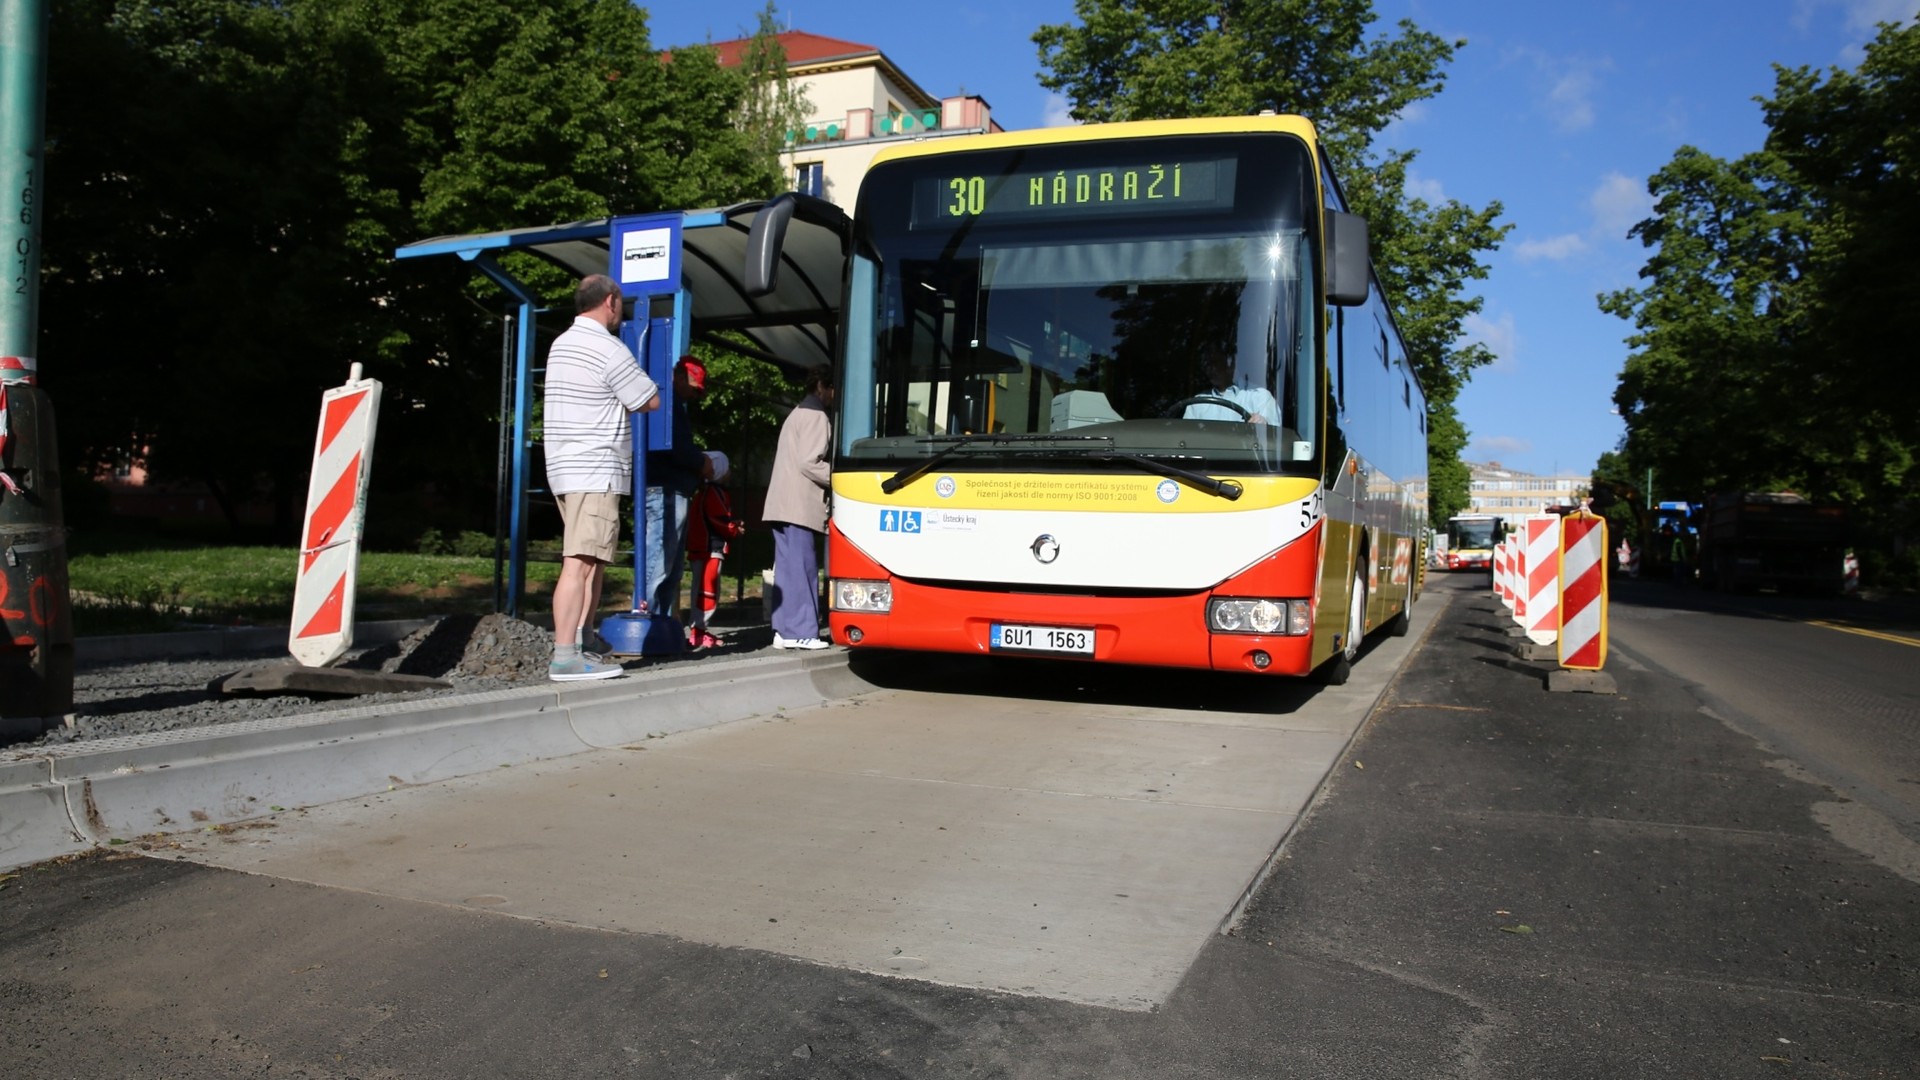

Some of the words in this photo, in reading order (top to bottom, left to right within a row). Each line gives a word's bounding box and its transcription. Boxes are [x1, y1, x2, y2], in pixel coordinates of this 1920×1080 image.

[949, 176, 985, 216] 30
[1029, 163, 1181, 206] NÁDRAŽÍ
[965, 479, 1012, 489] Společnost
[1013, 480, 1021, 489] je
[1023, 480, 1063, 489] držitelem
[1000, 490, 1029, 500] jakosti
[1030, 491, 1044, 499] dle
[1046, 492, 1073, 501] normy
[1075, 492, 1092, 500] ISO
[1093, 493, 1137, 501] 9001:2008
[1004, 628, 1033, 647] 6U1
[1047, 631, 1086, 650] 1563
